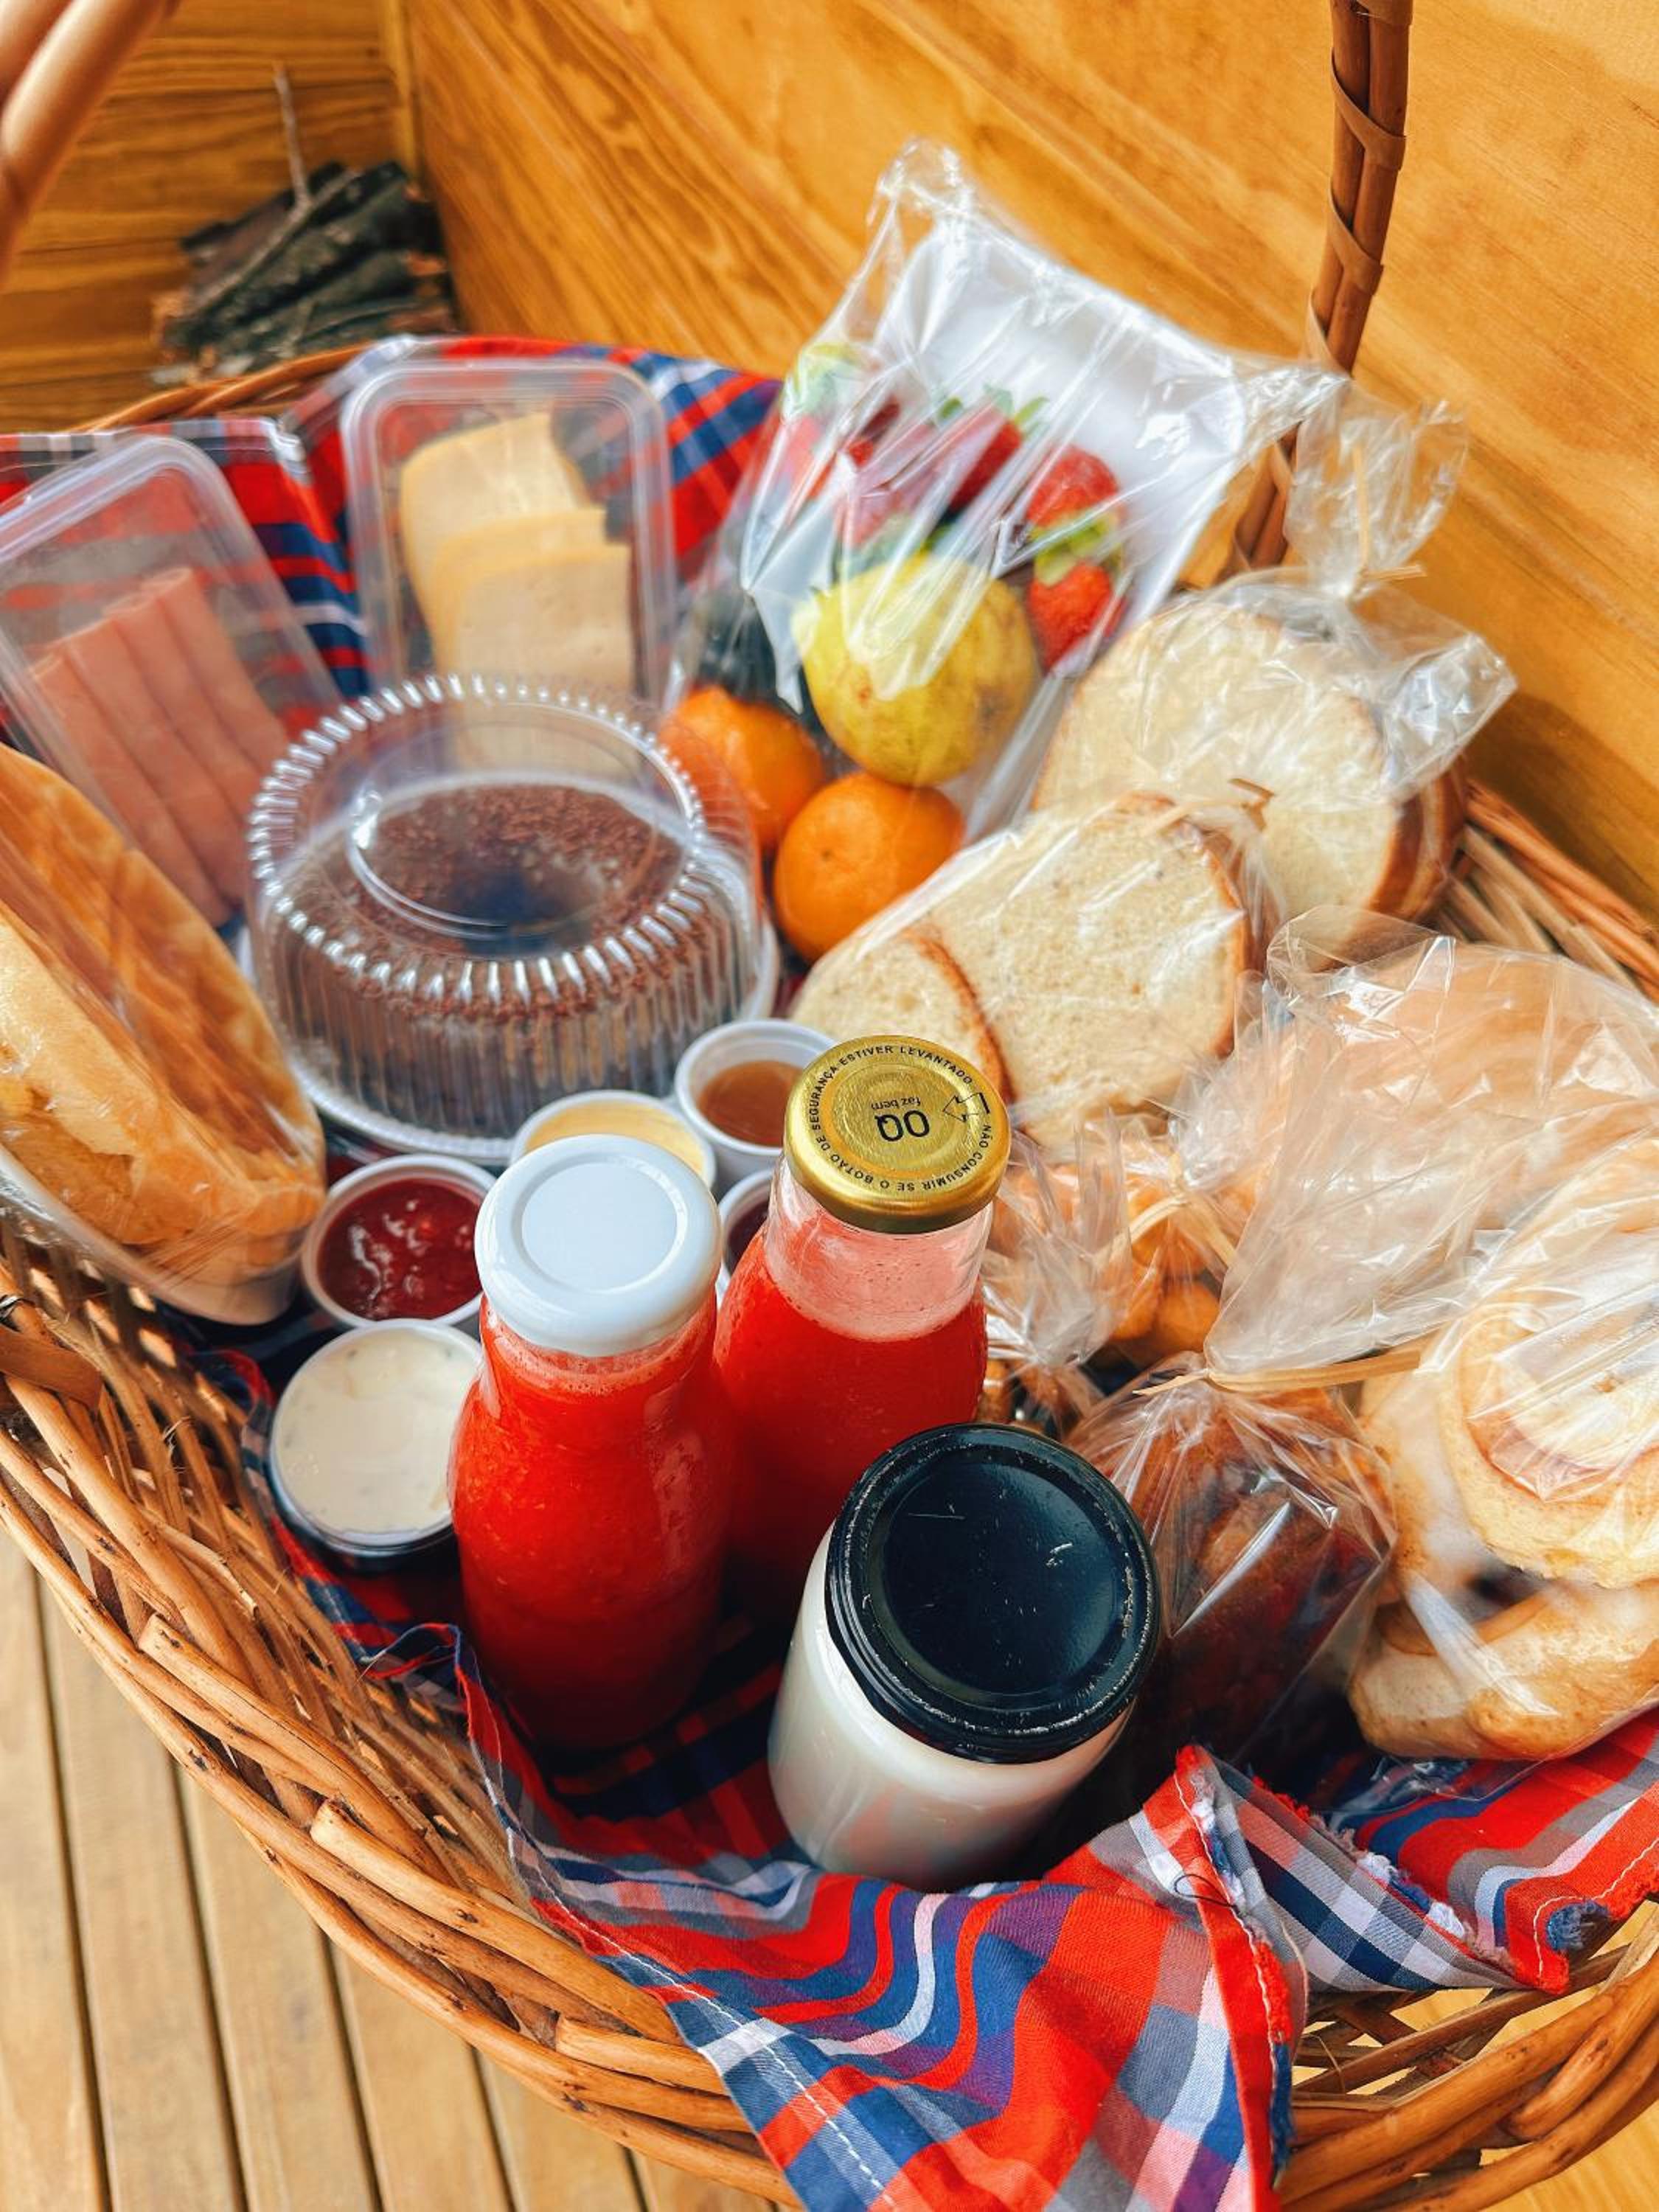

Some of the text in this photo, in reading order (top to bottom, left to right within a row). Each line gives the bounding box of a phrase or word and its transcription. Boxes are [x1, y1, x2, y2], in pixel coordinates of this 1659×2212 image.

[809, 1046, 992, 1192] NÃO CONSUMIR SE O BOTÃO DE SEGURANÇA ESTIVER LEVANTADO
[871, 1096, 921, 1110] faz bem
